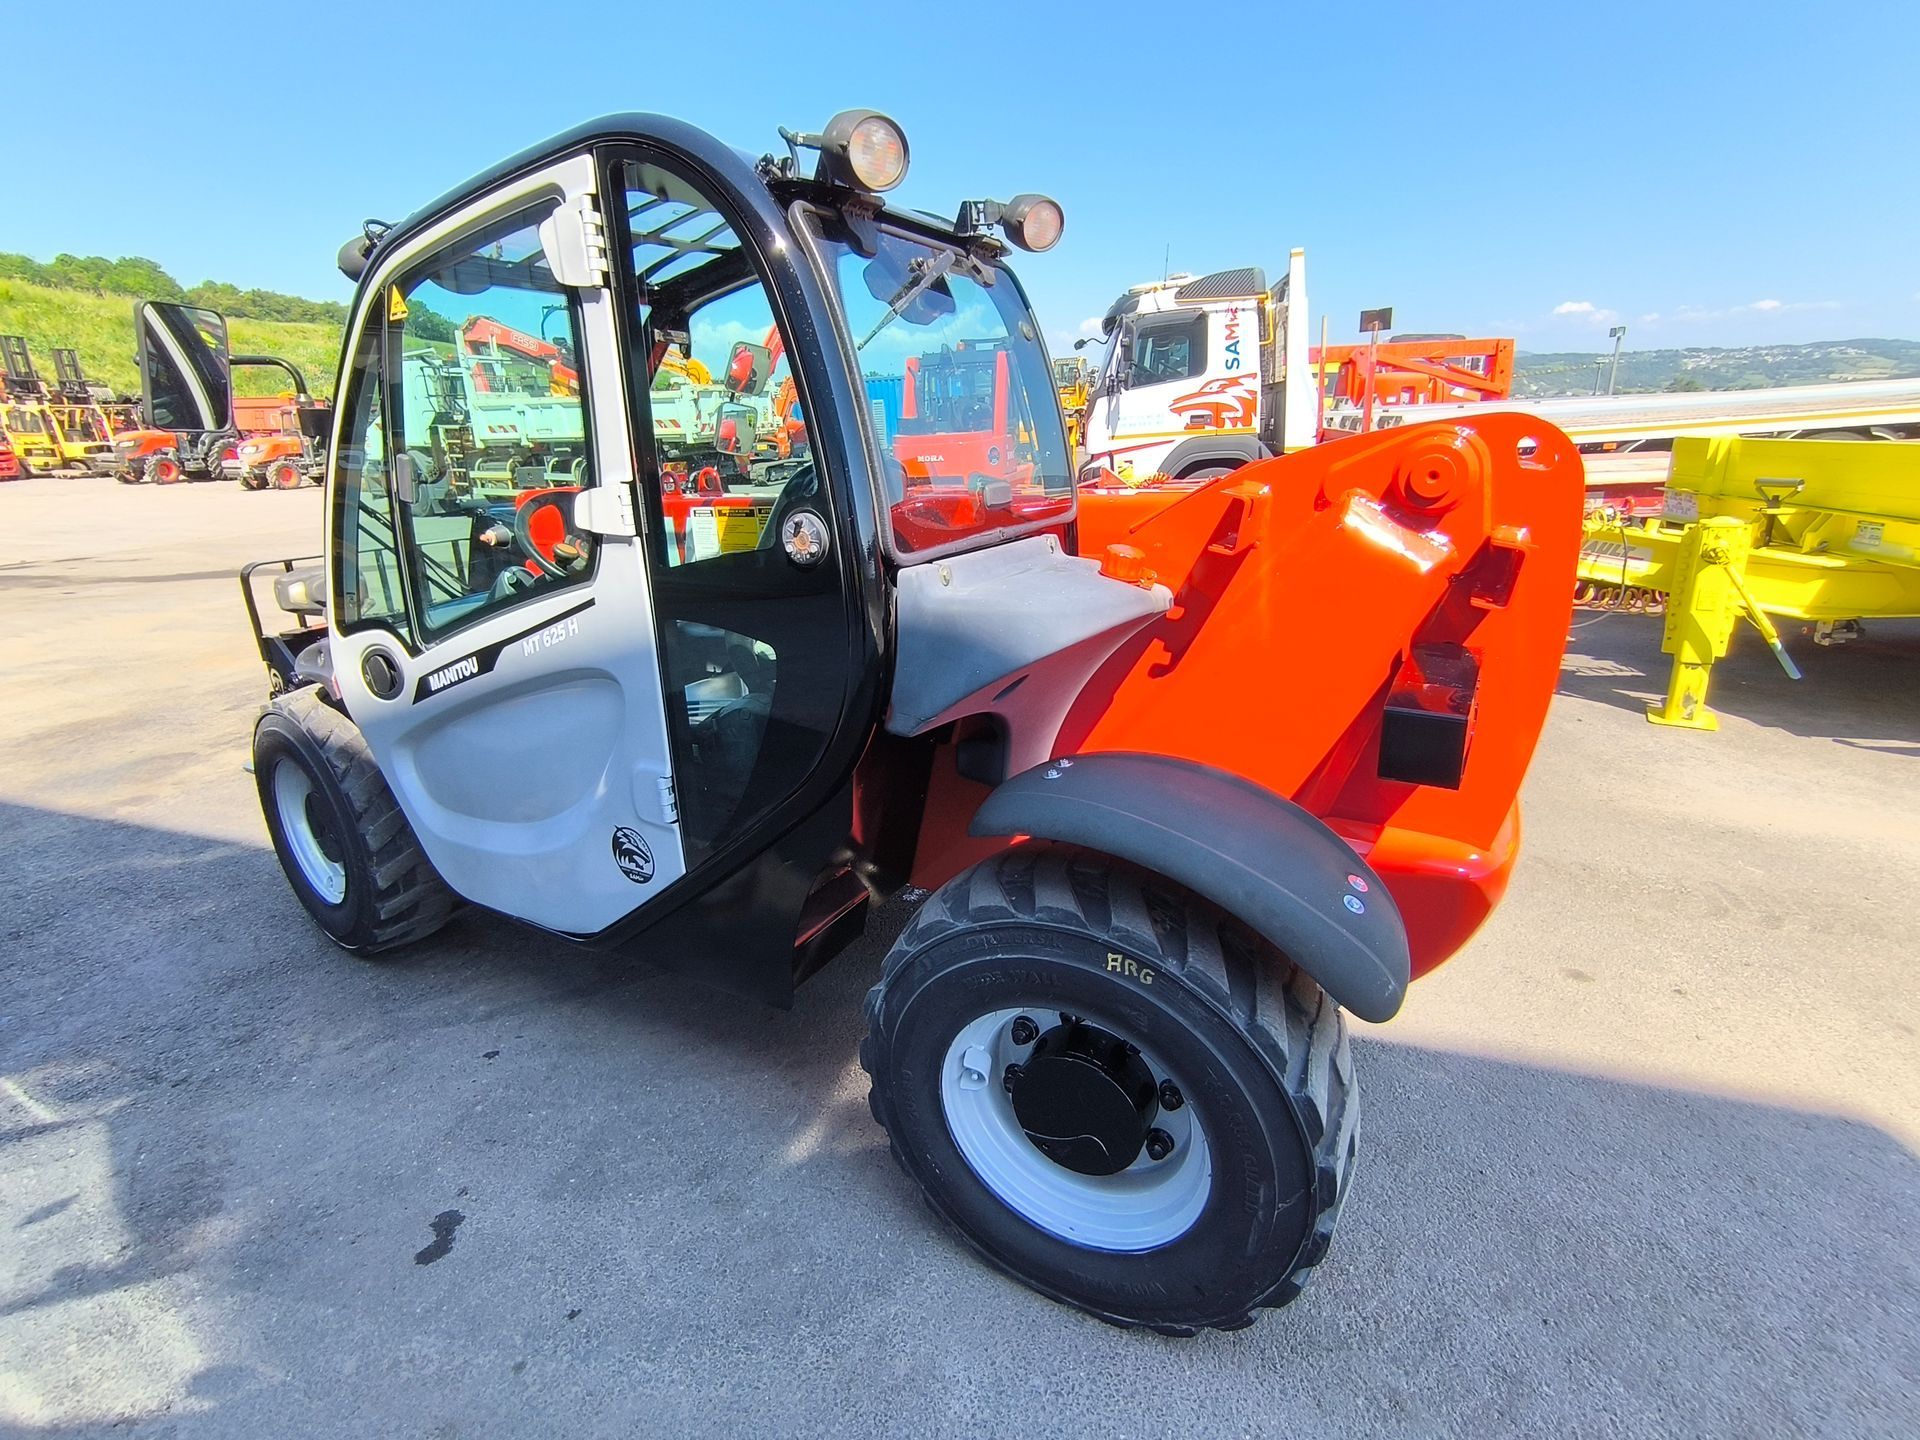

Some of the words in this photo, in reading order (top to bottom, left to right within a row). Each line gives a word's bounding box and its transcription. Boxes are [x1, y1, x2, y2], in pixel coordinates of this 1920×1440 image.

[522, 637, 541, 656] MT
[543, 624, 566, 648] 625
[568, 617, 579, 637] H
[428, 656, 479, 691] MANITOU
[1106, 952, 1155, 985] ARG
